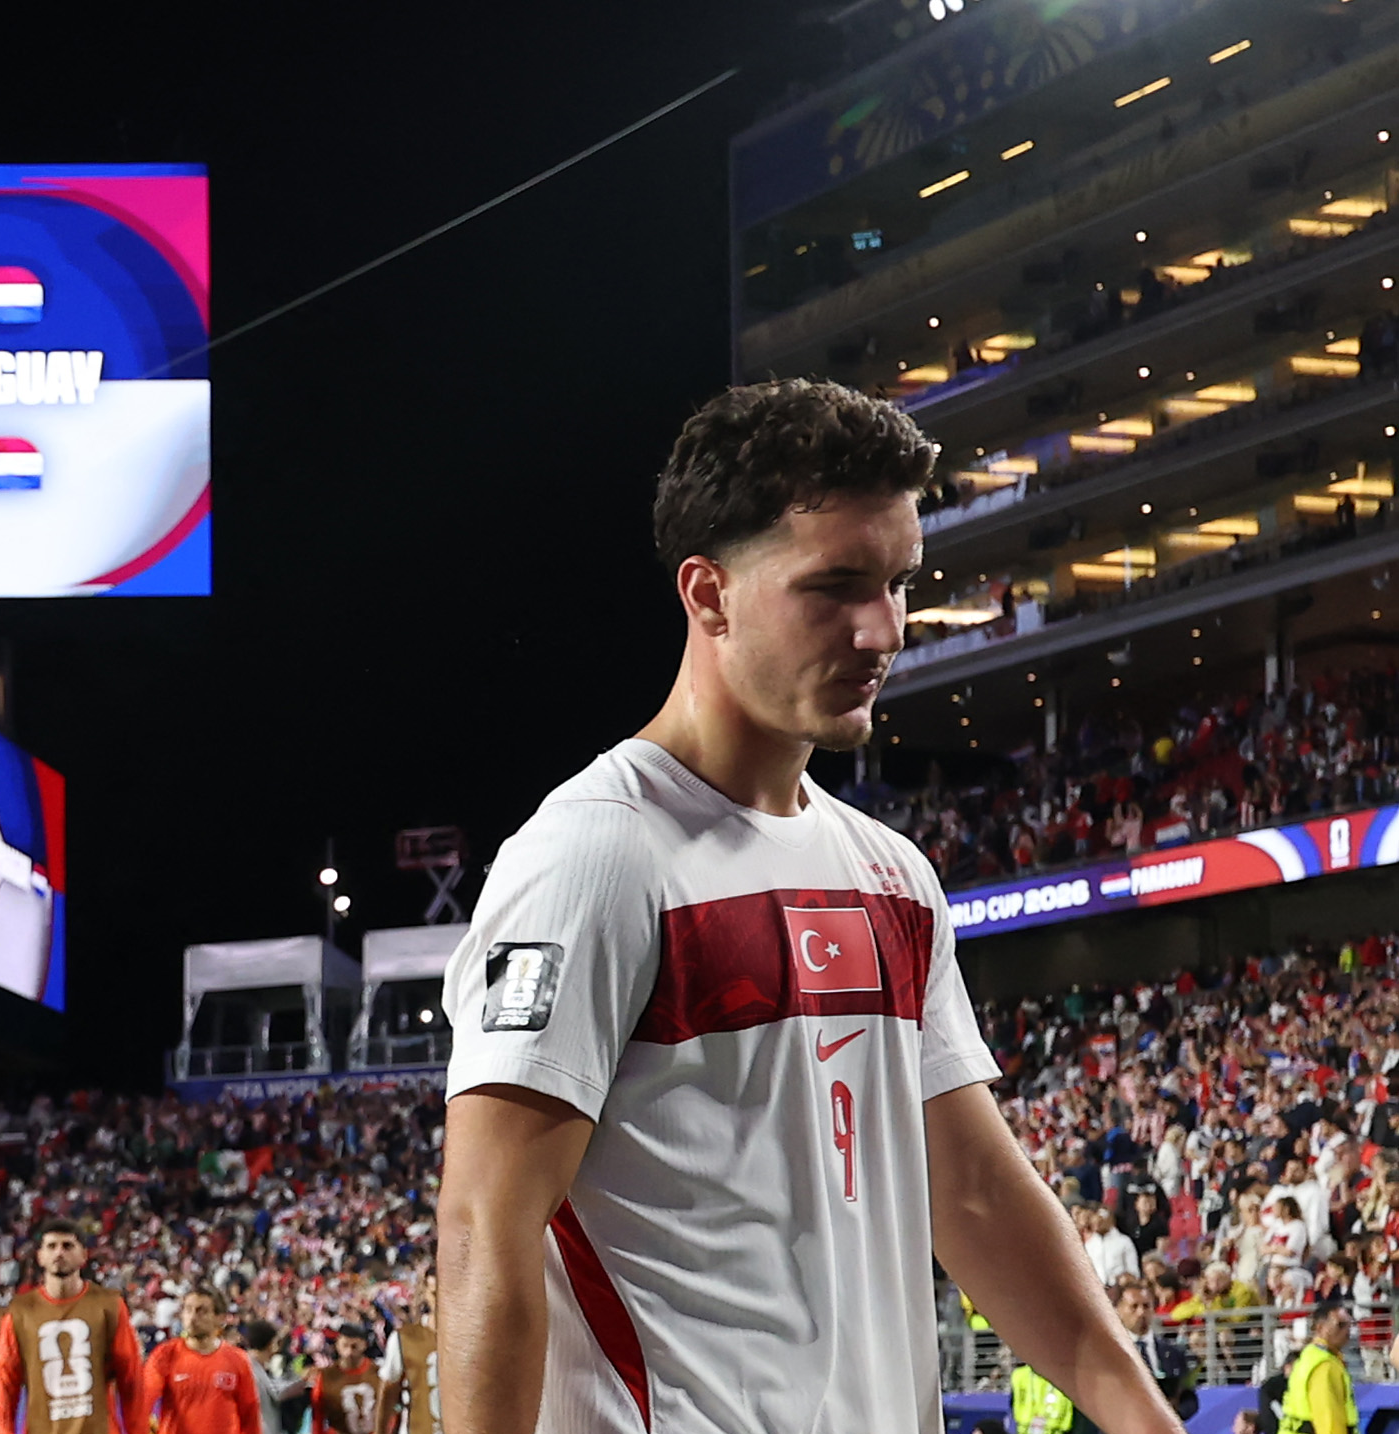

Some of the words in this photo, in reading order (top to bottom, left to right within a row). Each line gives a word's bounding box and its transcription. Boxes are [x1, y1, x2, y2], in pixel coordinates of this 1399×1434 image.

[986, 892, 1023, 923] CUP
[1023, 878, 1092, 916] 2026
[831, 1080, 858, 1203] 9
